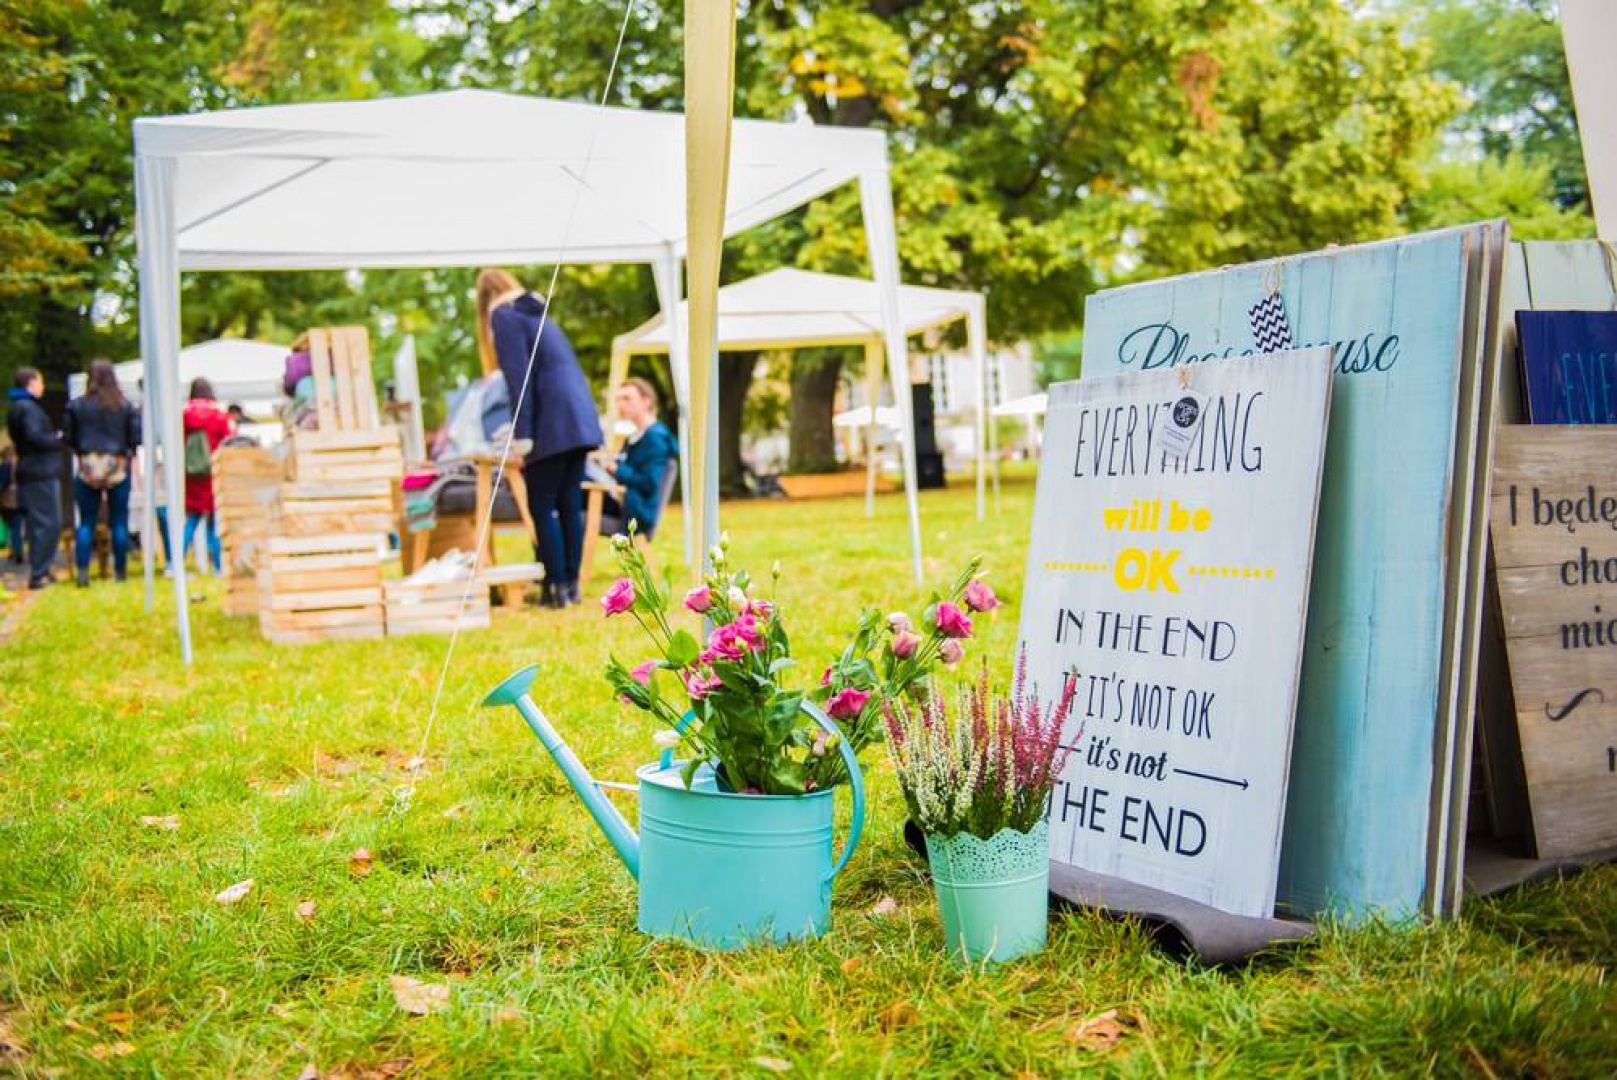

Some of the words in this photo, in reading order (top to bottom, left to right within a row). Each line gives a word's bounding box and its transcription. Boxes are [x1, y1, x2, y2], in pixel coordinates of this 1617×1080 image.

[1103, 501, 1159, 532] will
[1167, 501, 1212, 532] be
[1113, 549, 1182, 593] OK
[1056, 608, 1085, 646] IN
[1096, 611, 1153, 653] THE
[1161, 616, 1236, 662] END
[1086, 672, 1125, 723] IT'S
[1130, 681, 1176, 732] NOT
[1182, 689, 1215, 739] OK
[1087, 735, 1121, 771] it's
[1124, 751, 1168, 782] not
[1120, 796, 1207, 857] END
